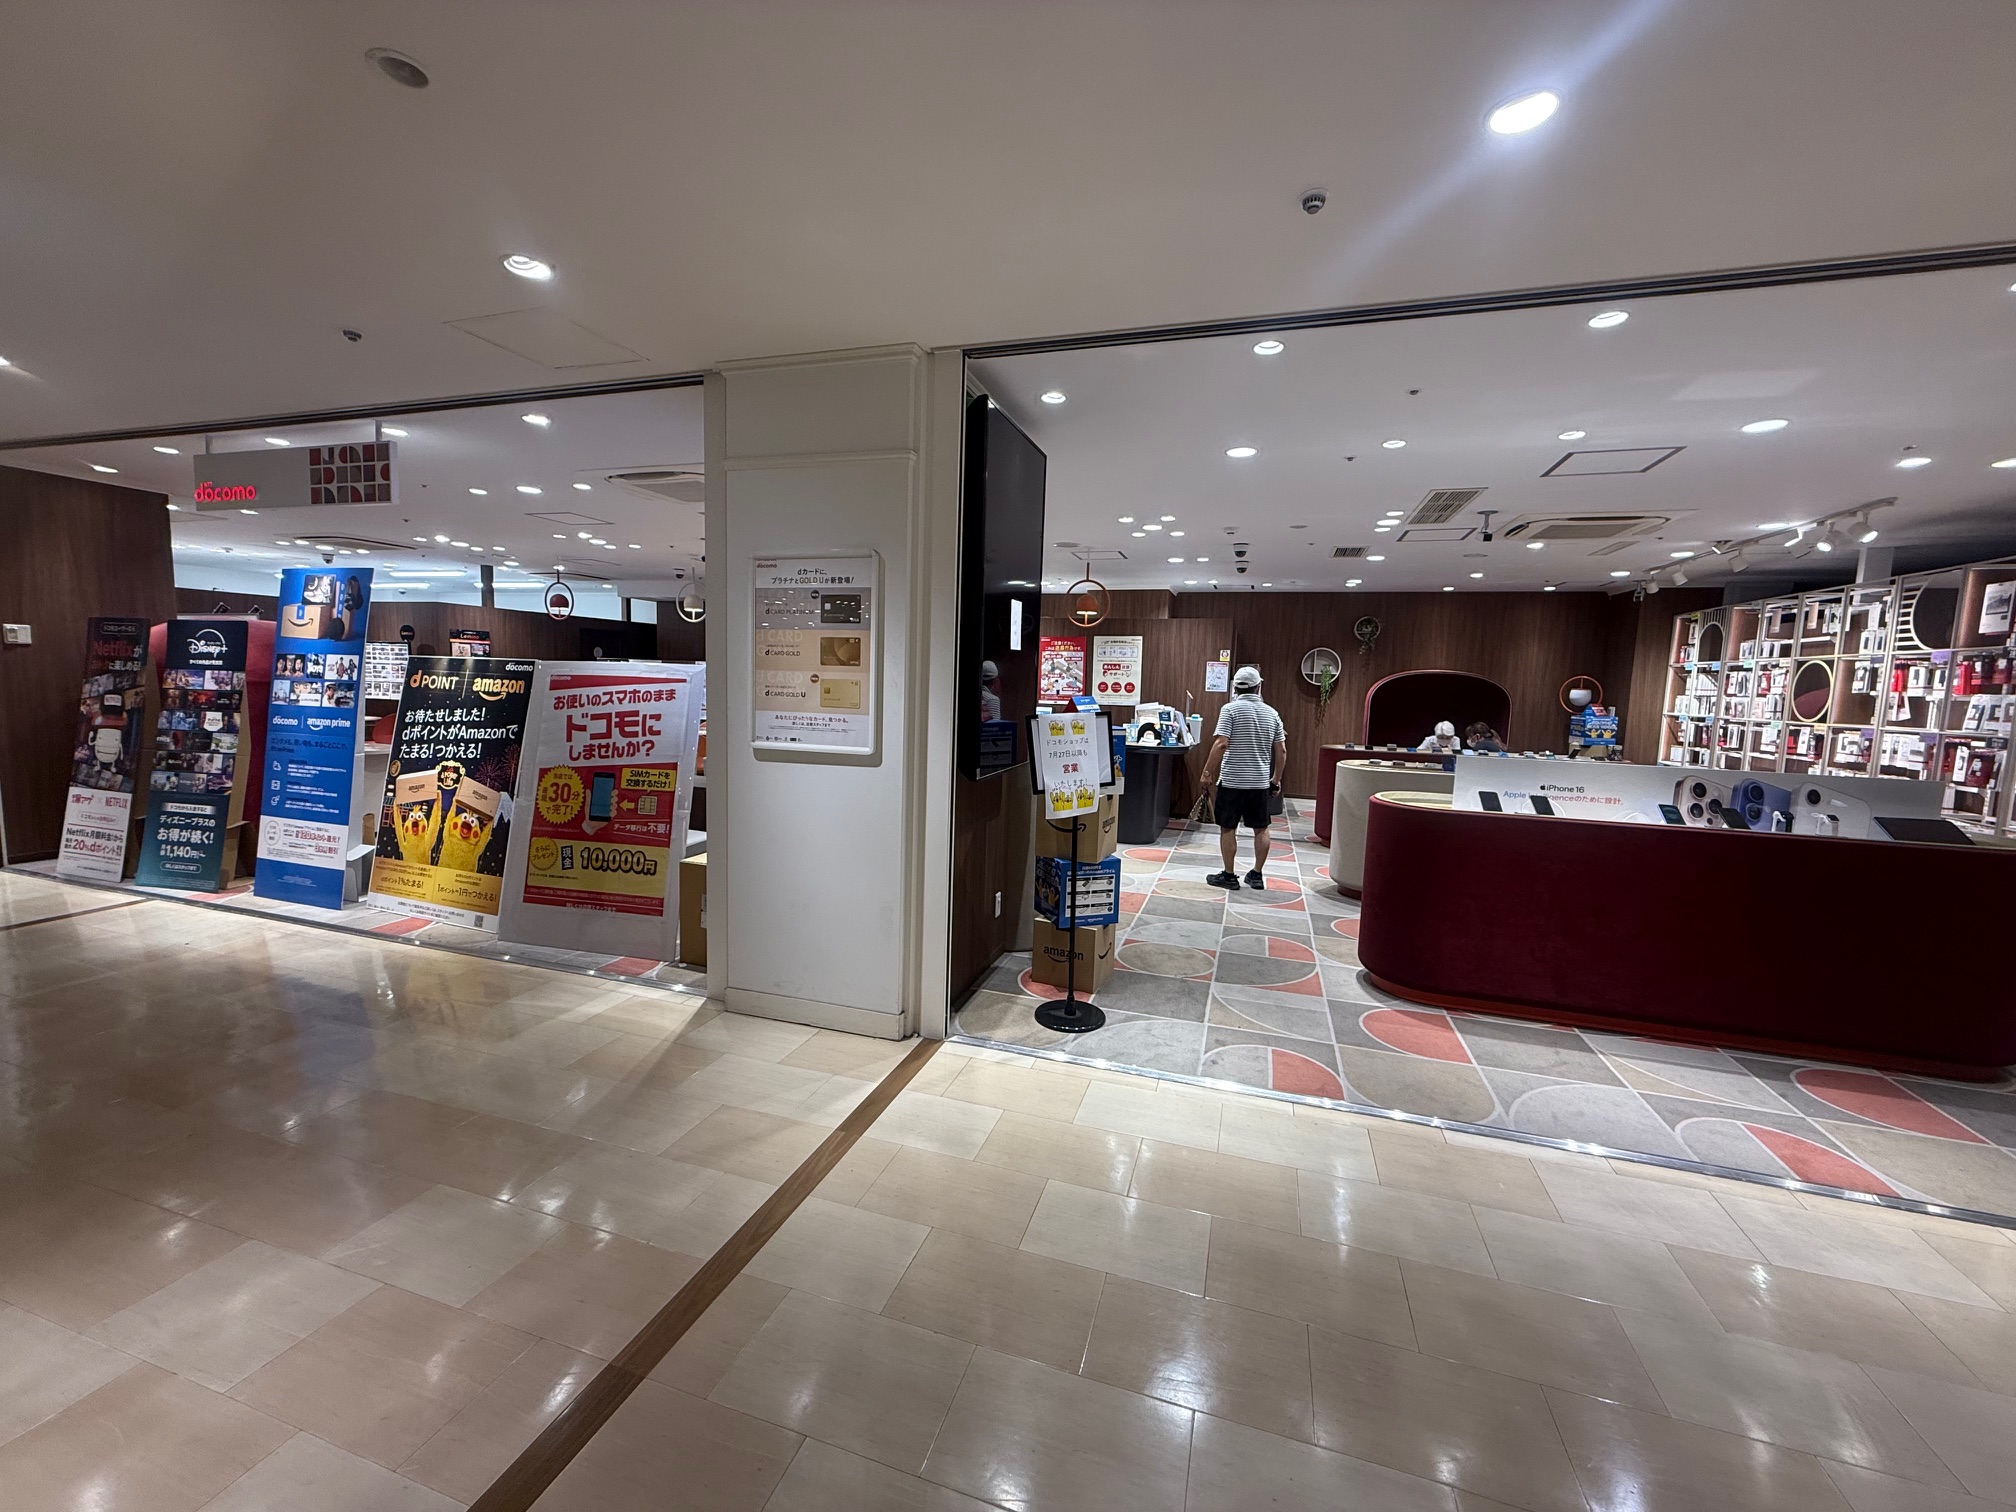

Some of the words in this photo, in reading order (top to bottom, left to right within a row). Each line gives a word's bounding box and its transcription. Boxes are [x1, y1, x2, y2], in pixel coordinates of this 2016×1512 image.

[194, 483, 256, 502] docomo
[505, 662, 534, 672] docomo
[473, 677, 525, 697] amazon
[553, 689, 677, 711] お使いのスマホのまま
[405, 707, 486, 723] お待たせしました!
[272, 715, 298, 726] docomo
[307, 718, 331, 729] amazon
[331, 718, 351, 728] prime
[566, 710, 662, 743] ドコモに
[402, 724, 518, 740] dポイントがAmazonで
[1046, 738, 1089, 747] ドコモショップは
[568, 740, 655, 762] しませんか?
[1048, 749, 1088, 759] 7月27日以降も
[1062, 762, 1079, 774] 営業
[630, 770, 671, 780] SIMカードを
[625, 778, 671, 789] 交換するだけ!
[1053, 778, 1088, 788] いたします!
[1546, 784, 1575, 793] iPhone
[1575, 786, 1585, 794] 16
[549, 783, 580, 803] 30分
[1502, 790, 1527, 799] Apple
[545, 805, 574, 816] で完了!
[160, 815, 216, 827] ディズニープラスの
[613, 823, 670, 834] データ移行は不要!
[157, 827, 214, 844] お得が続く!
[535, 844, 551, 852] さらに
[532, 852, 555, 860] プレゼント
[561, 846, 573, 869] 現金
[580, 847, 657, 876] 10,000円
